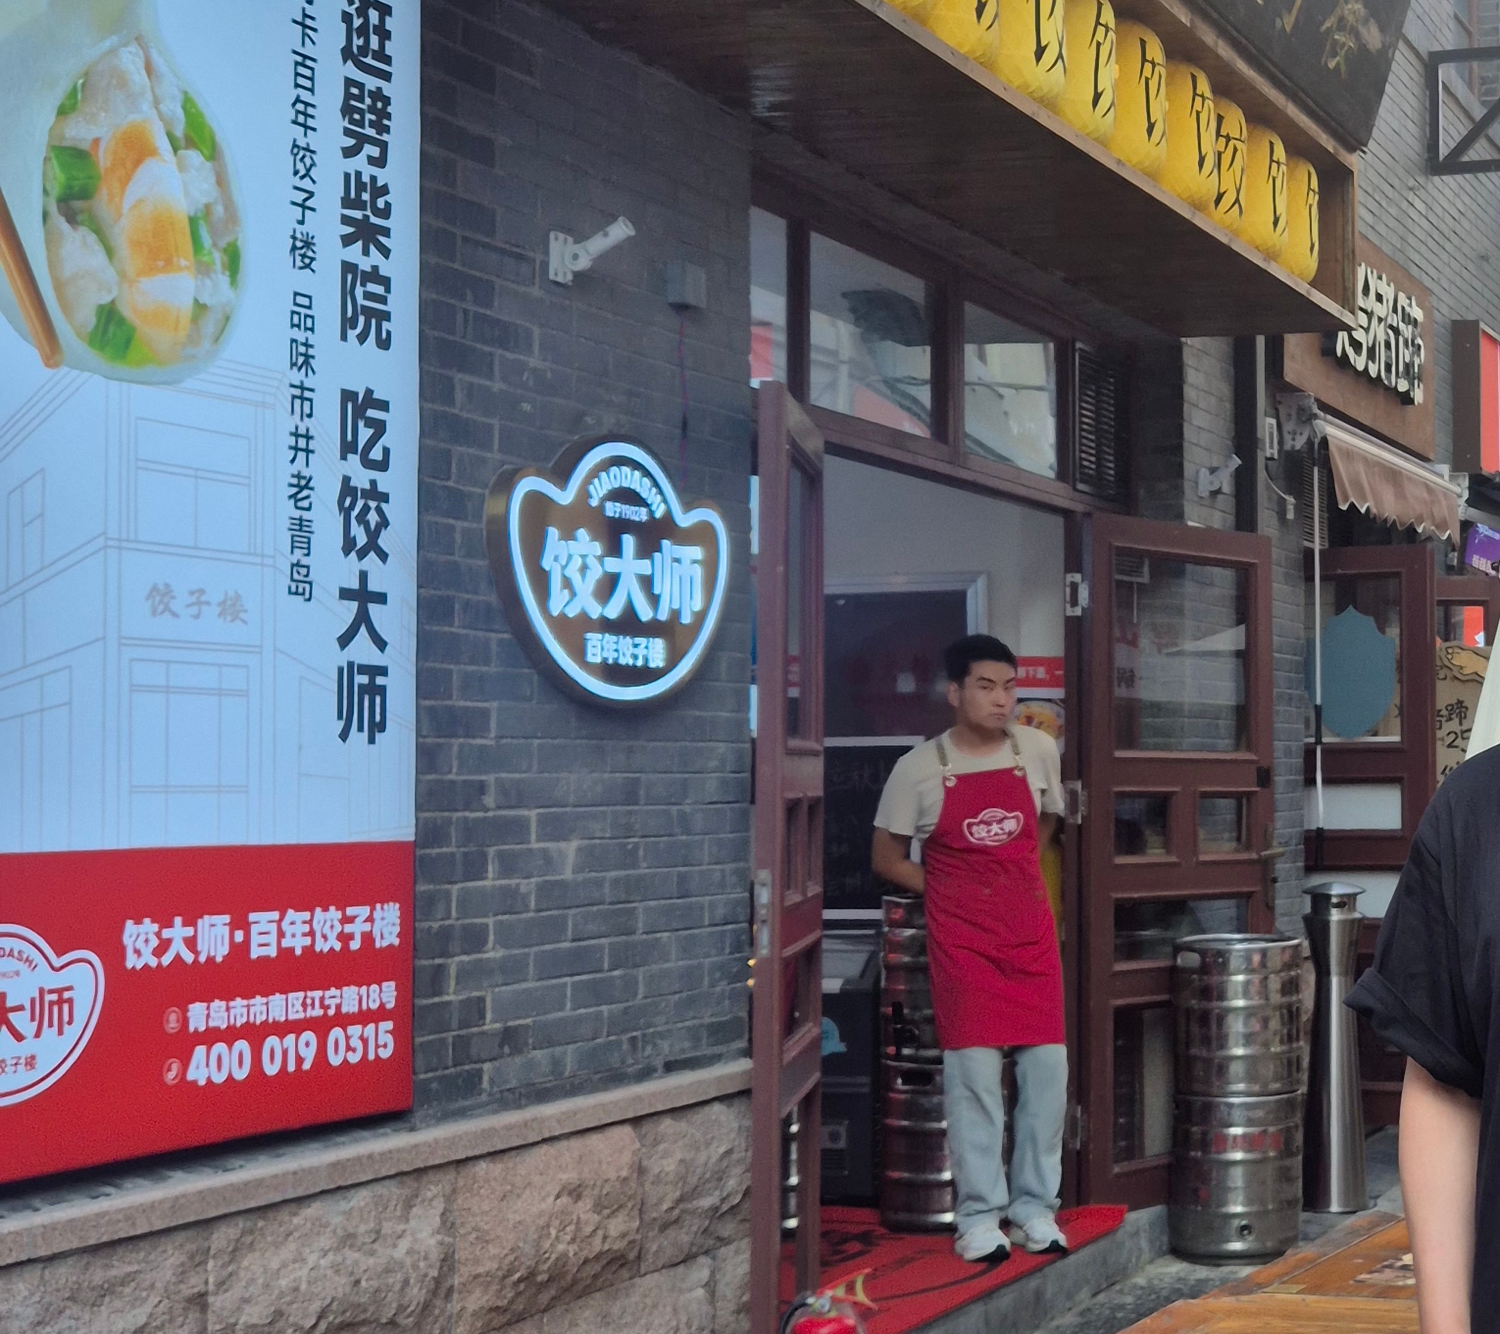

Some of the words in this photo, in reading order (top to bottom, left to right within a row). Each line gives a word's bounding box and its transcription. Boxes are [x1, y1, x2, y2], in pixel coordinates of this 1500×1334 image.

[1214, 112, 1244, 218] 饺
[287, 292, 317, 603] 品味市井老青岛
[587, 466, 667, 519] JIAODASHI
[336, 388, 391, 745] 吃饺大师
[540, 526, 703, 624] 饺大师
[145, 580, 249, 626] 饺子楼
[584, 632, 666, 668] 百年饺子楼
[186, 981, 397, 1033] 青岛市市南区江宁路18号
[186, 1039, 251, 1086] 400
[262, 1030, 318, 1078] 019
[327, 1021, 394, 1067] 0315
